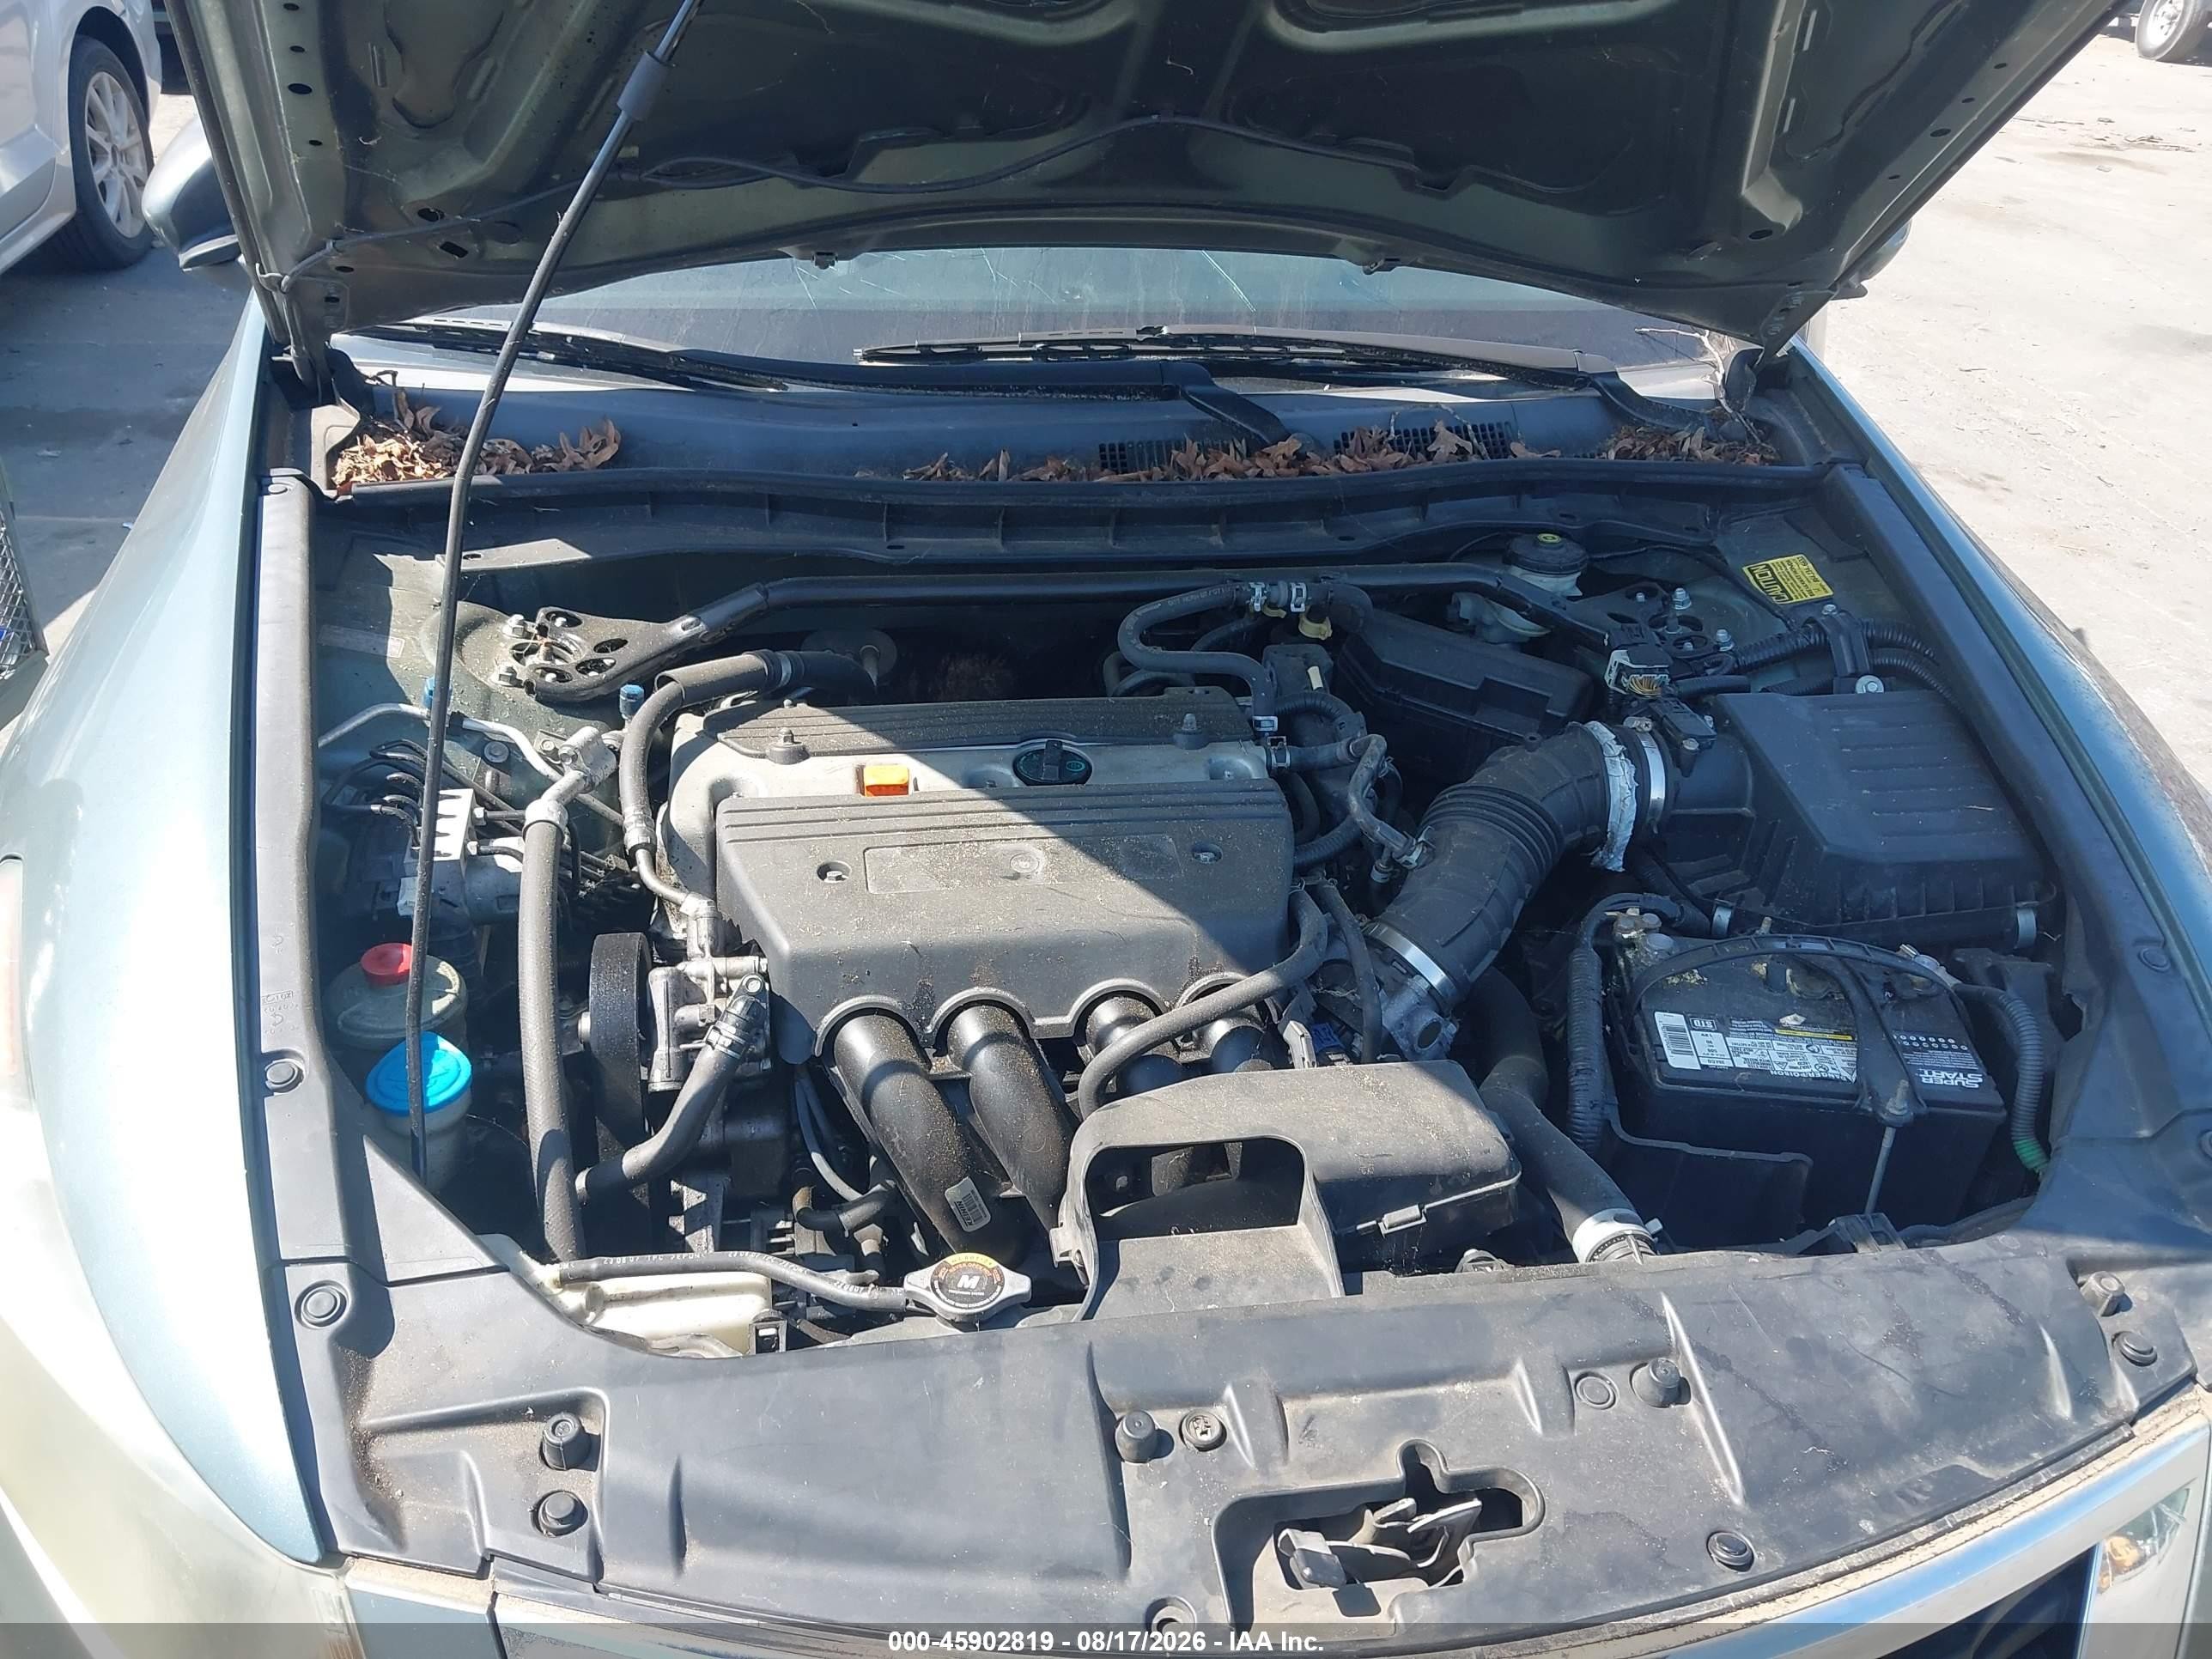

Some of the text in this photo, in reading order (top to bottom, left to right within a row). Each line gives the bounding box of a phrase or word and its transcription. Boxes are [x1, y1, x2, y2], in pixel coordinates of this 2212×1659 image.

[1751, 564, 1790, 603] CAUTION
[1918, 1069, 1984, 1083] START
[1921, 1077, 1979, 1089] SUPER
[957, 1274, 981, 1289] M
